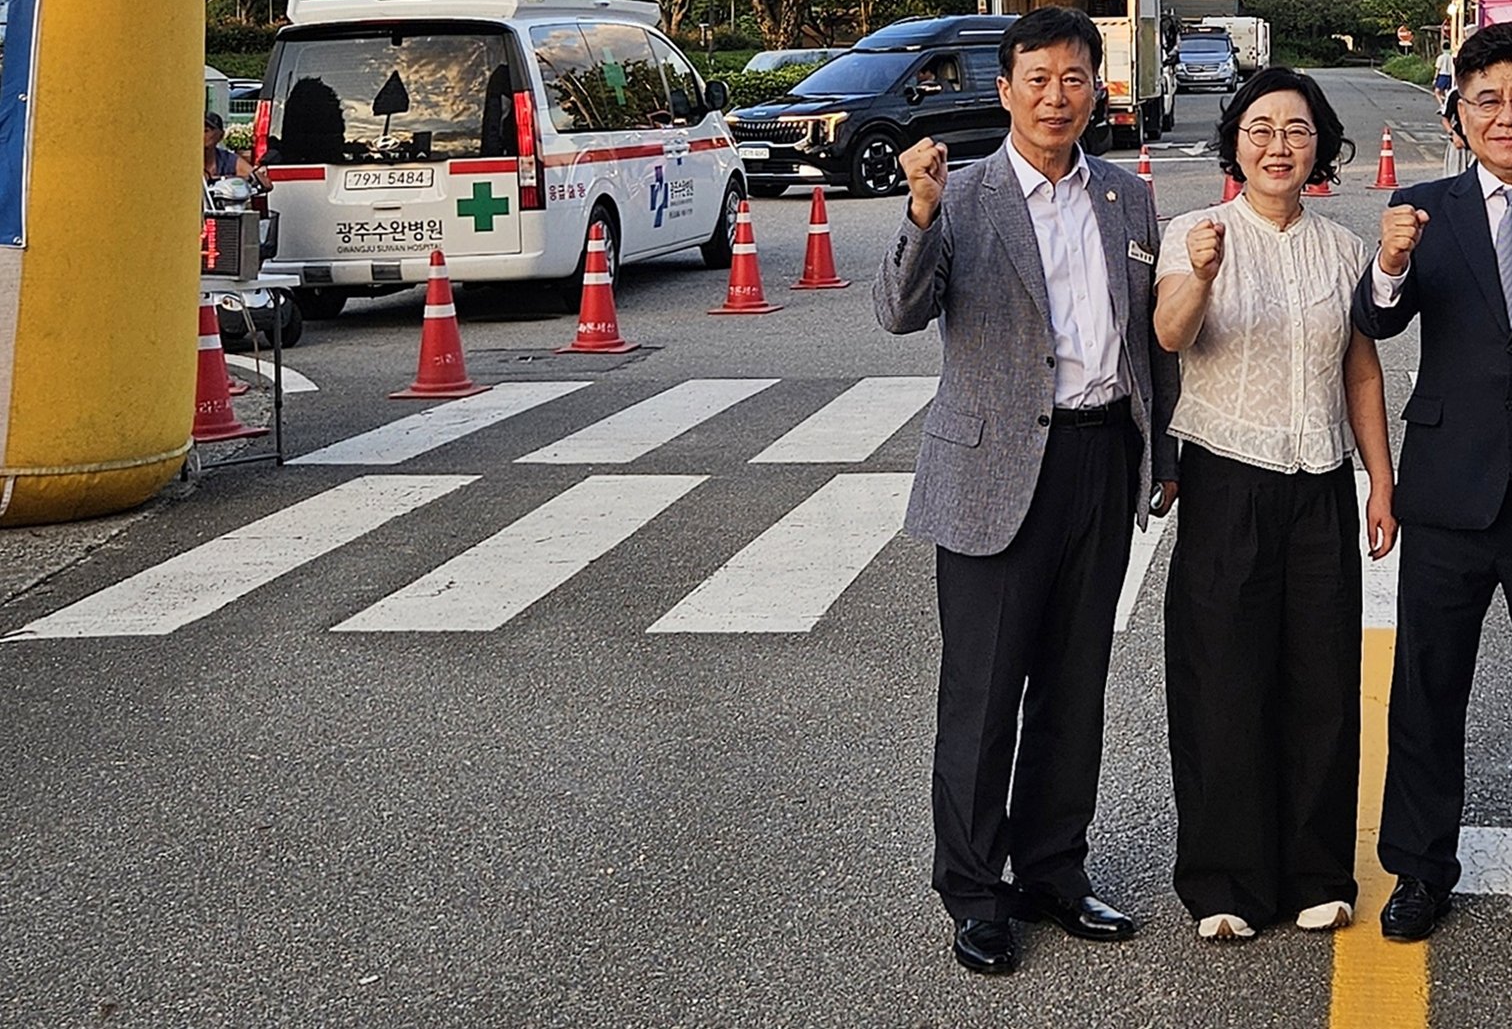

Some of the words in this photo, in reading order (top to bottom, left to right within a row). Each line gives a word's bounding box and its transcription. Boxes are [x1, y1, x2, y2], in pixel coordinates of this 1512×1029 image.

[387, 170, 425, 186] 5484
[336, 219, 443, 244] 광주수완병원
[337, 245, 376, 254] GWANGJU
[377, 244, 406, 253] SUWAN
[407, 242, 443, 252] HOSPITAL
